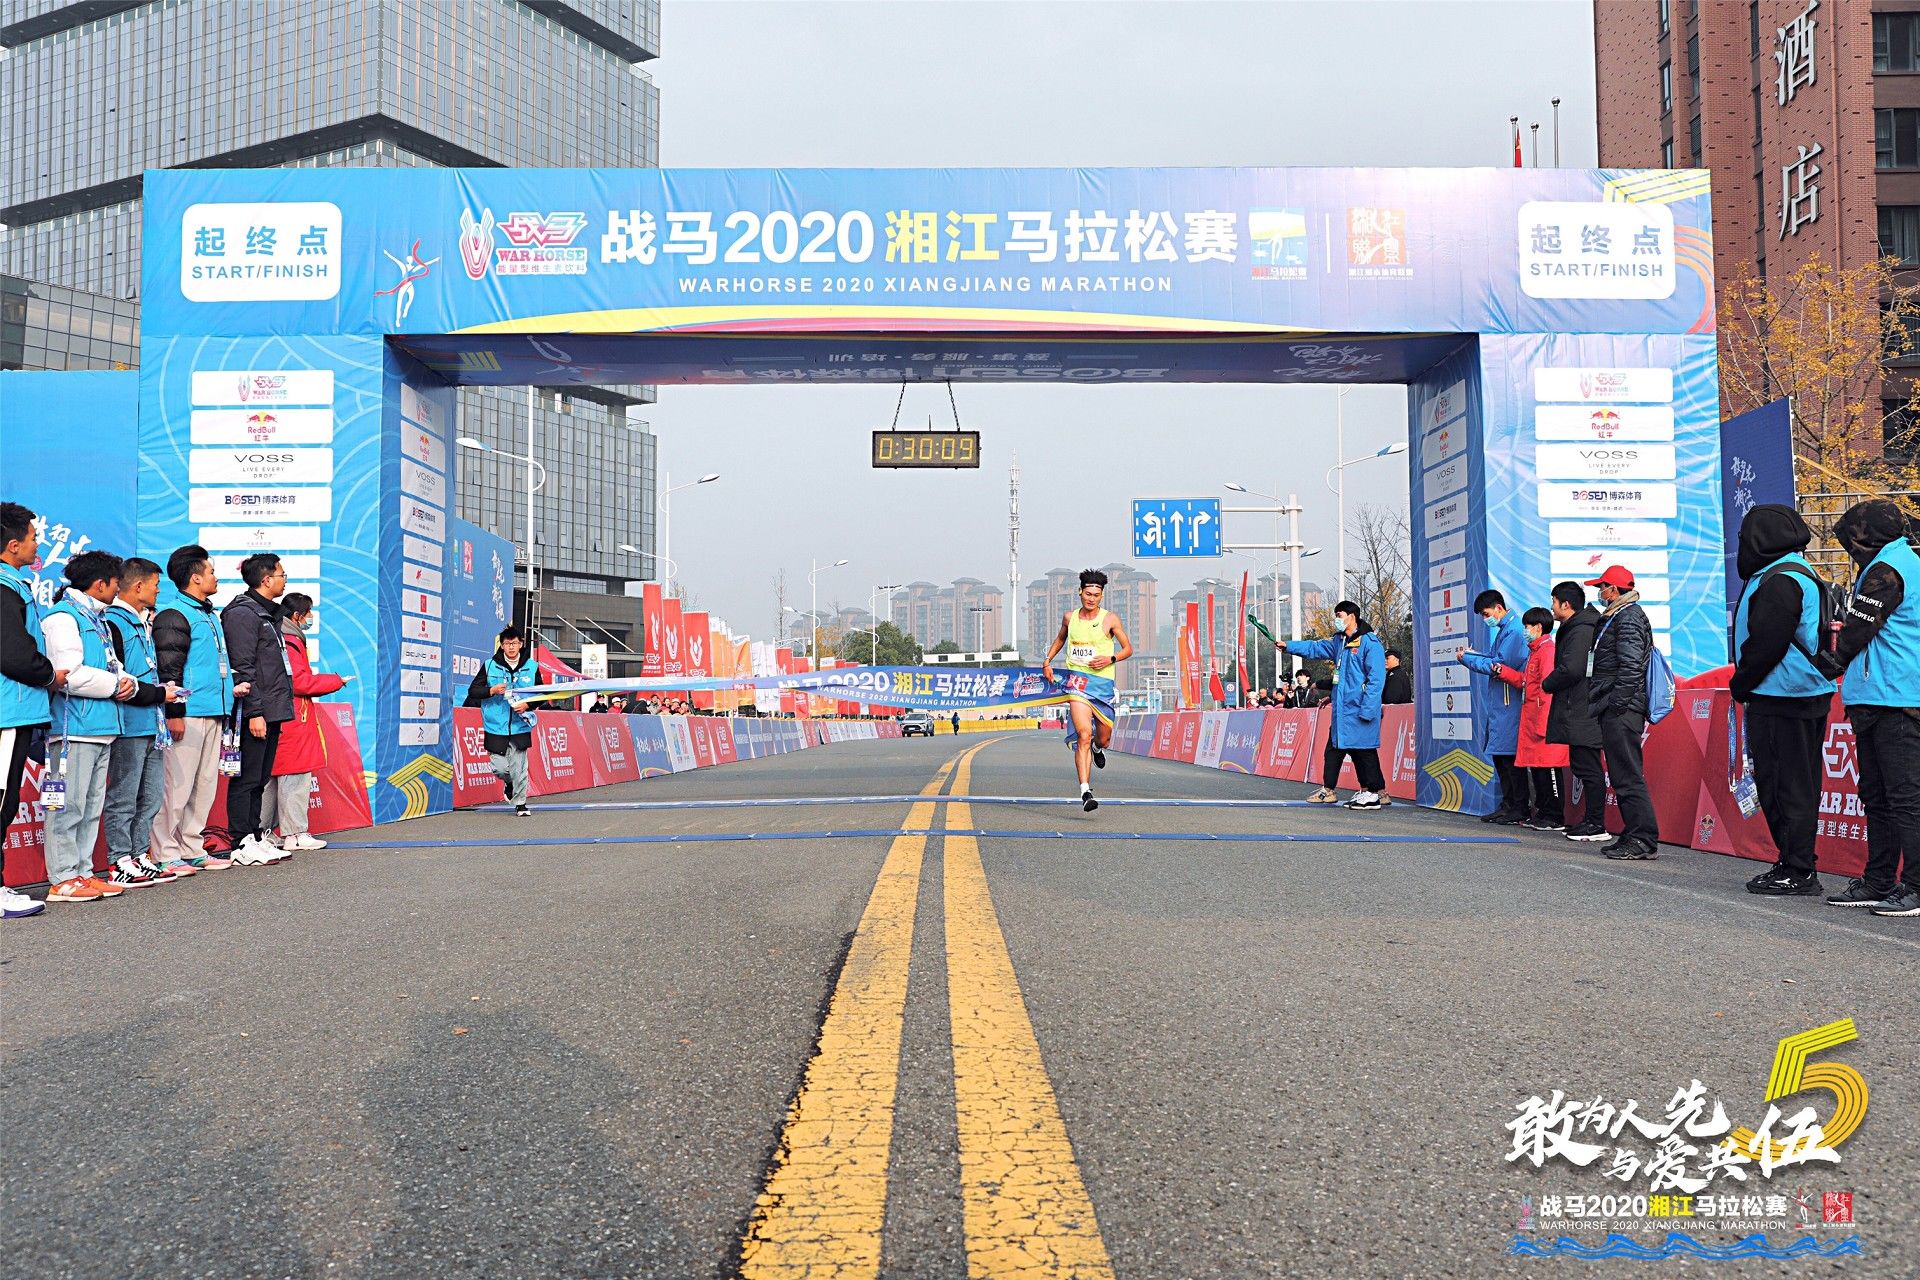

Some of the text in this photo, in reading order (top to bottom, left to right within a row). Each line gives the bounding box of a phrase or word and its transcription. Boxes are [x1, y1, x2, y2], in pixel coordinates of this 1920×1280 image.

[1773, 0, 1823, 241] 酒店
[194, 225, 328, 257] 起终点
[601, 209, 1239, 265] 战马2020湘江马拉松赛
[1531, 224, 1662, 255] 起终点
[498, 250, 586, 262] WAR HORSE
[191, 264, 328, 279] START/FINISH
[1530, 263, 1664, 277] START/FINISH
[679, 277, 1172, 293] WARHORSE 2020 XIANGJIANG MARATHON
[247, 426, 276, 434] RedBull
[879, 437, 974, 460] 0:30:09
[1579, 450, 1638, 459] VOSS
[234, 454, 295, 463] VOSS
[416, 469, 436, 486] VOSS
[1436, 465, 1456, 480] VOSS
[224, 494, 296, 506] BOSEN 博森体育
[1572, 490, 1642, 501] BOSEN 博森体育
[869, 693, 888, 701] 2020
[891, 695, 938, 706] XIANGJIANG
[940, 699, 977, 707] MARATHON
[1819, 791, 1842, 814] AR
